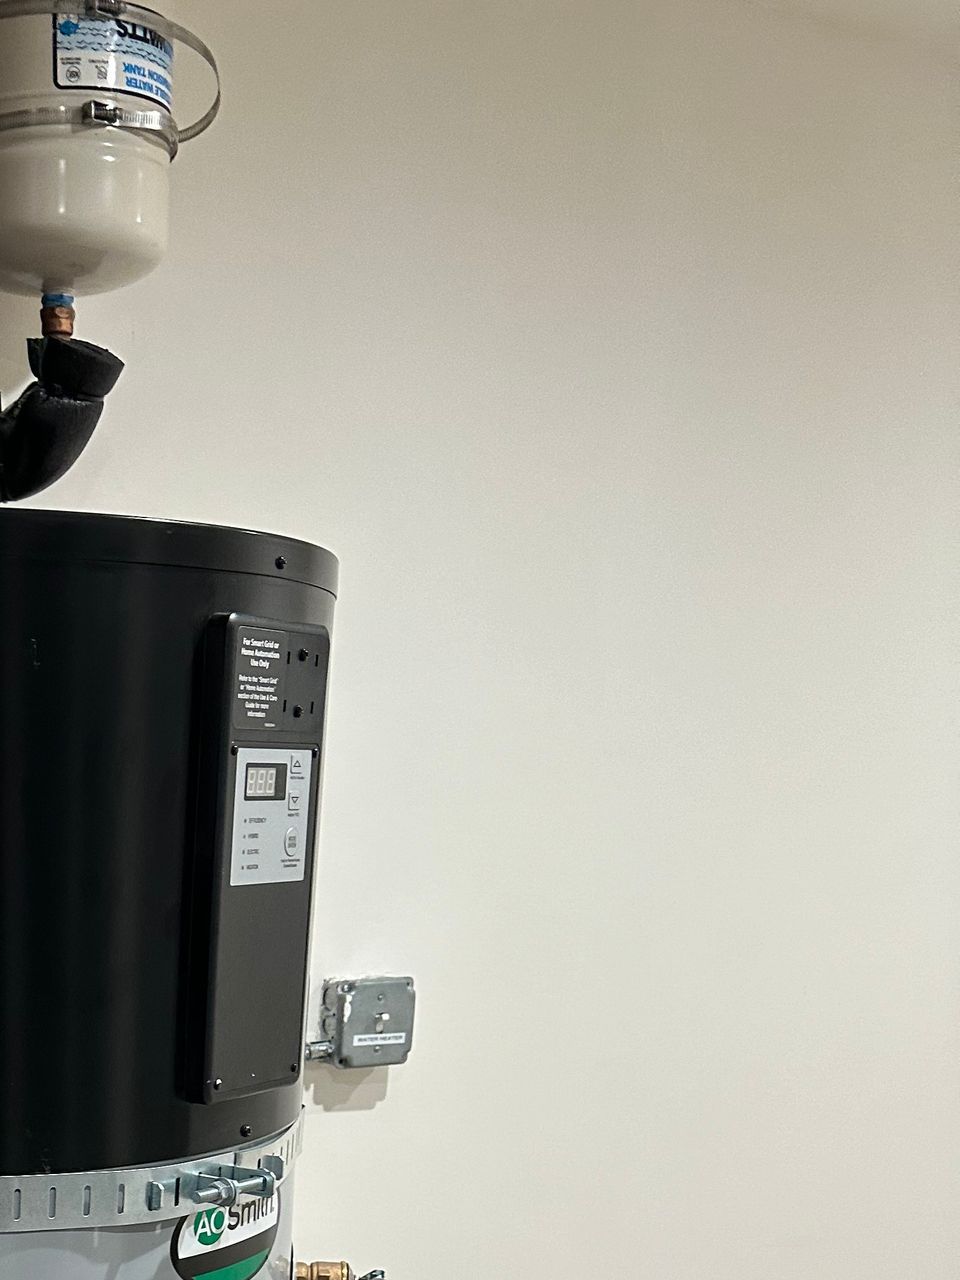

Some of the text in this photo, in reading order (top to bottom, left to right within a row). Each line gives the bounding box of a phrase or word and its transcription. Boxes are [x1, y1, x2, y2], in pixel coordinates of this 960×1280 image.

[123, 62, 146, 77] TANK
[125, 76, 153, 93] WATER
[251, 638, 265, 648] Smart
[258, 659, 270, 669] Only
